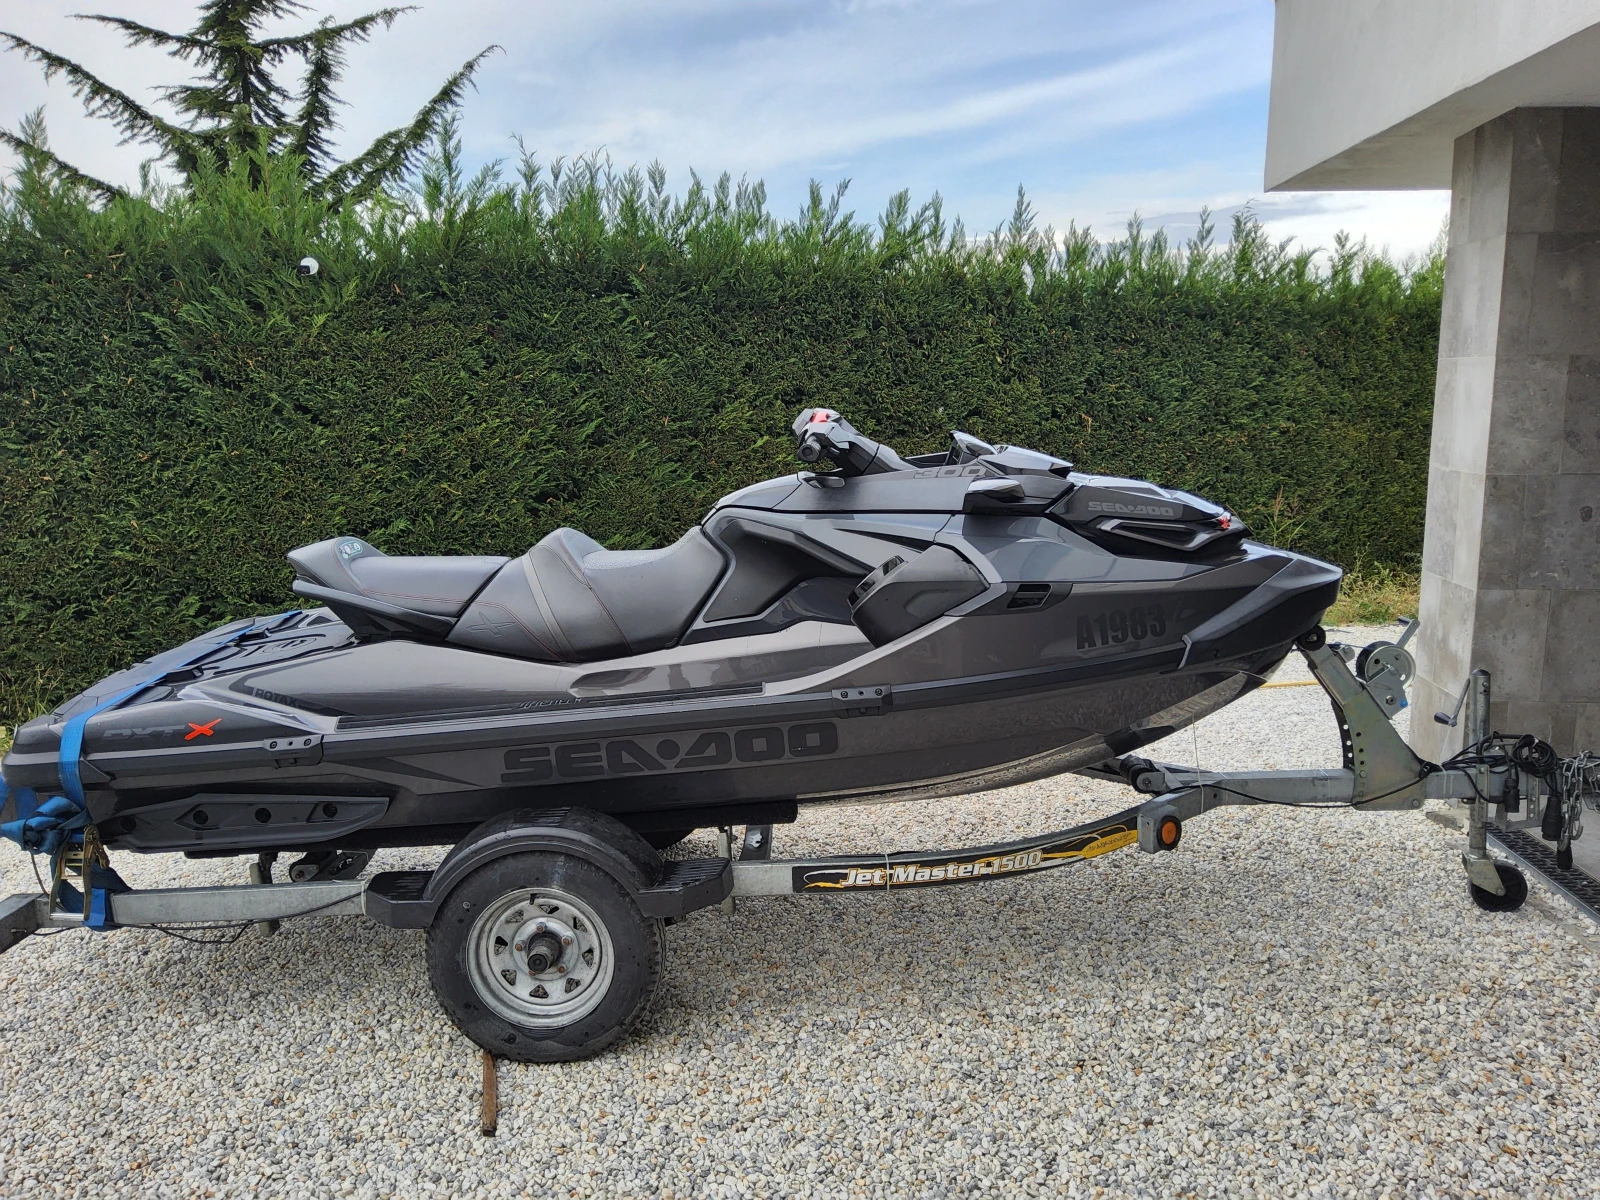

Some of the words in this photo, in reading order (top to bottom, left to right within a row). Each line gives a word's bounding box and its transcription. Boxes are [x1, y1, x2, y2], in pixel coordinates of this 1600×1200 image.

[1076, 603, 1167, 650] A1983
[255, 688, 298, 707] ROTAX
[840, 867, 887, 887] Jet
[890, 861, 986, 885] Master
[990, 850, 1043, 875] 1500
